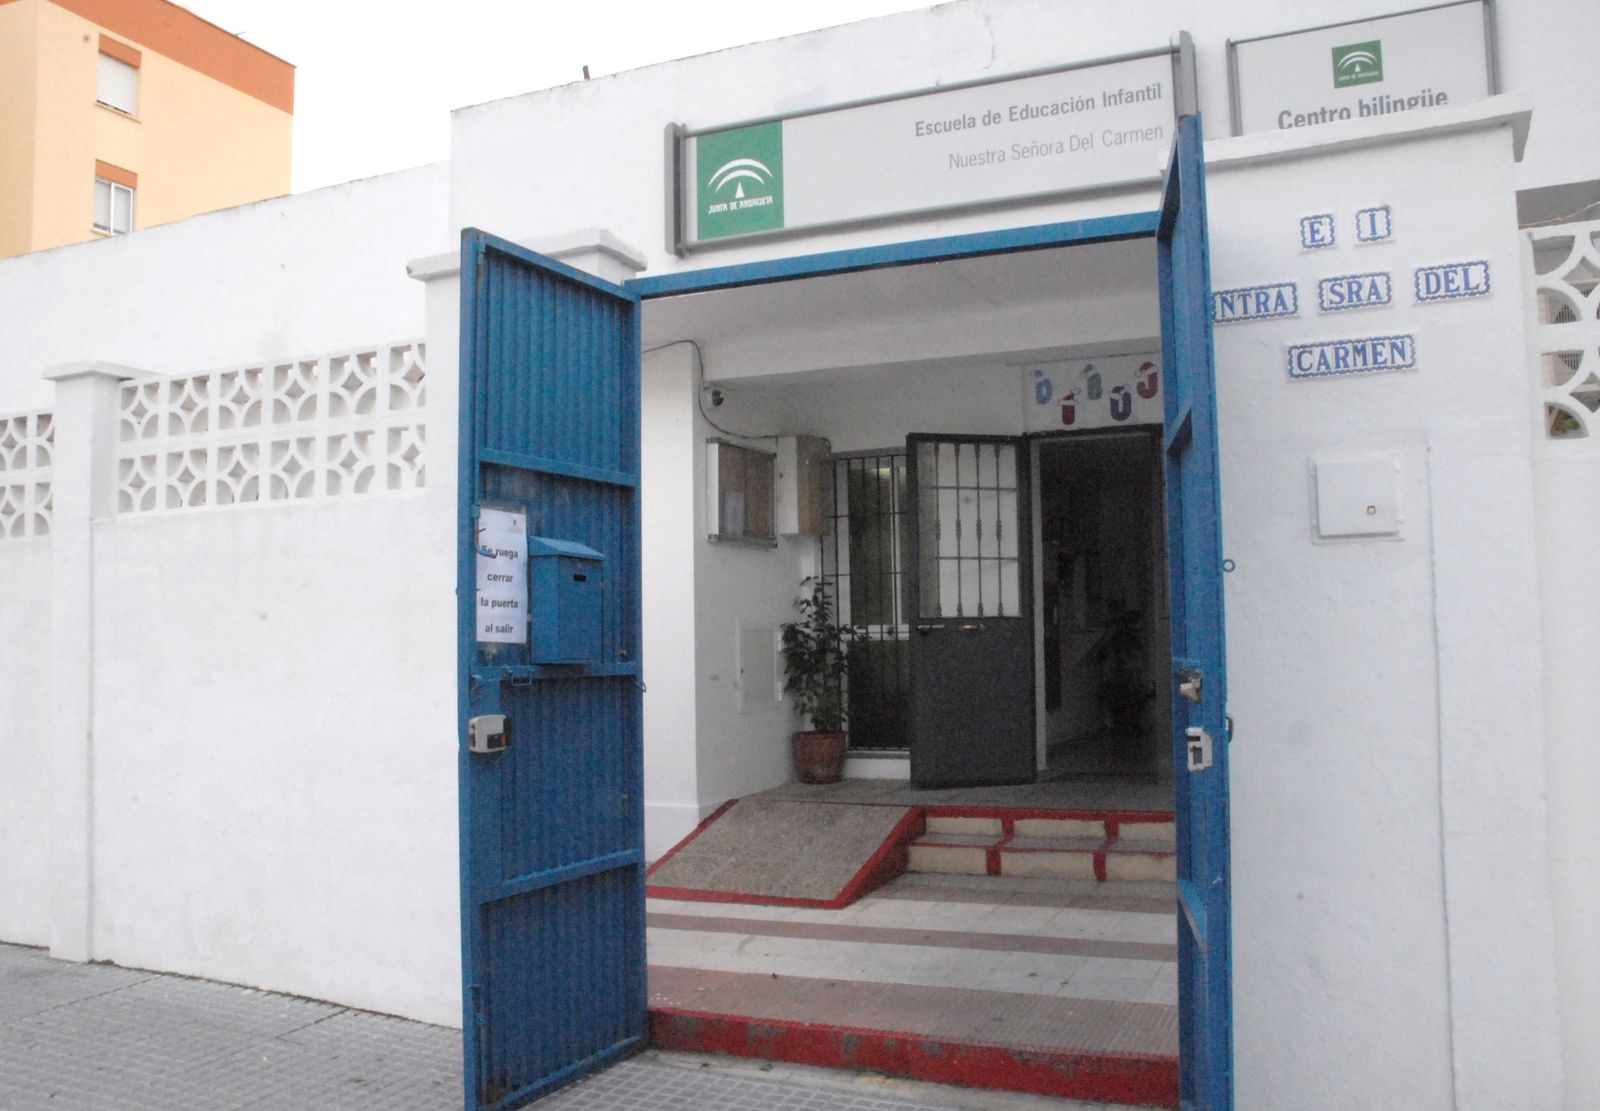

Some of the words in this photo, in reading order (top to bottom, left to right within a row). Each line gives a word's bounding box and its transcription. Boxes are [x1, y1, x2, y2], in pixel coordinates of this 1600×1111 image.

[915, 115, 976, 137] Escuela
[982, 109, 1002, 125] de
[1009, 95, 1095, 123] Educación
[1102, 82, 1162, 108] Infantil
[1278, 106, 1351, 130] Centro
[1358, 89, 1448, 117] bilingüe
[949, 149, 1006, 170] Nuestra
[1011, 138, 1064, 161] Señora
[1069, 133, 1094, 152] Del
[1101, 126, 1164, 147] Carmen
[708, 203, 727, 214] JUNTA
[730, 202, 738, 210] DE
[1308, 220, 1326, 244] E
[1368, 212, 1378, 236] I
[1221, 290, 1289, 318] NTRA
[1328, 277, 1383, 306] SRA
[1424, 266, 1481, 296] DEL
[1297, 340, 1406, 372] CARMEN
[495, 548, 518, 559] ruega
[487, 573, 513, 582] cerrar
[480, 597, 489, 607] la
[491, 599, 518, 609] puerta
[485, 623, 493, 633] al
[495, 624, 514, 634] salir
